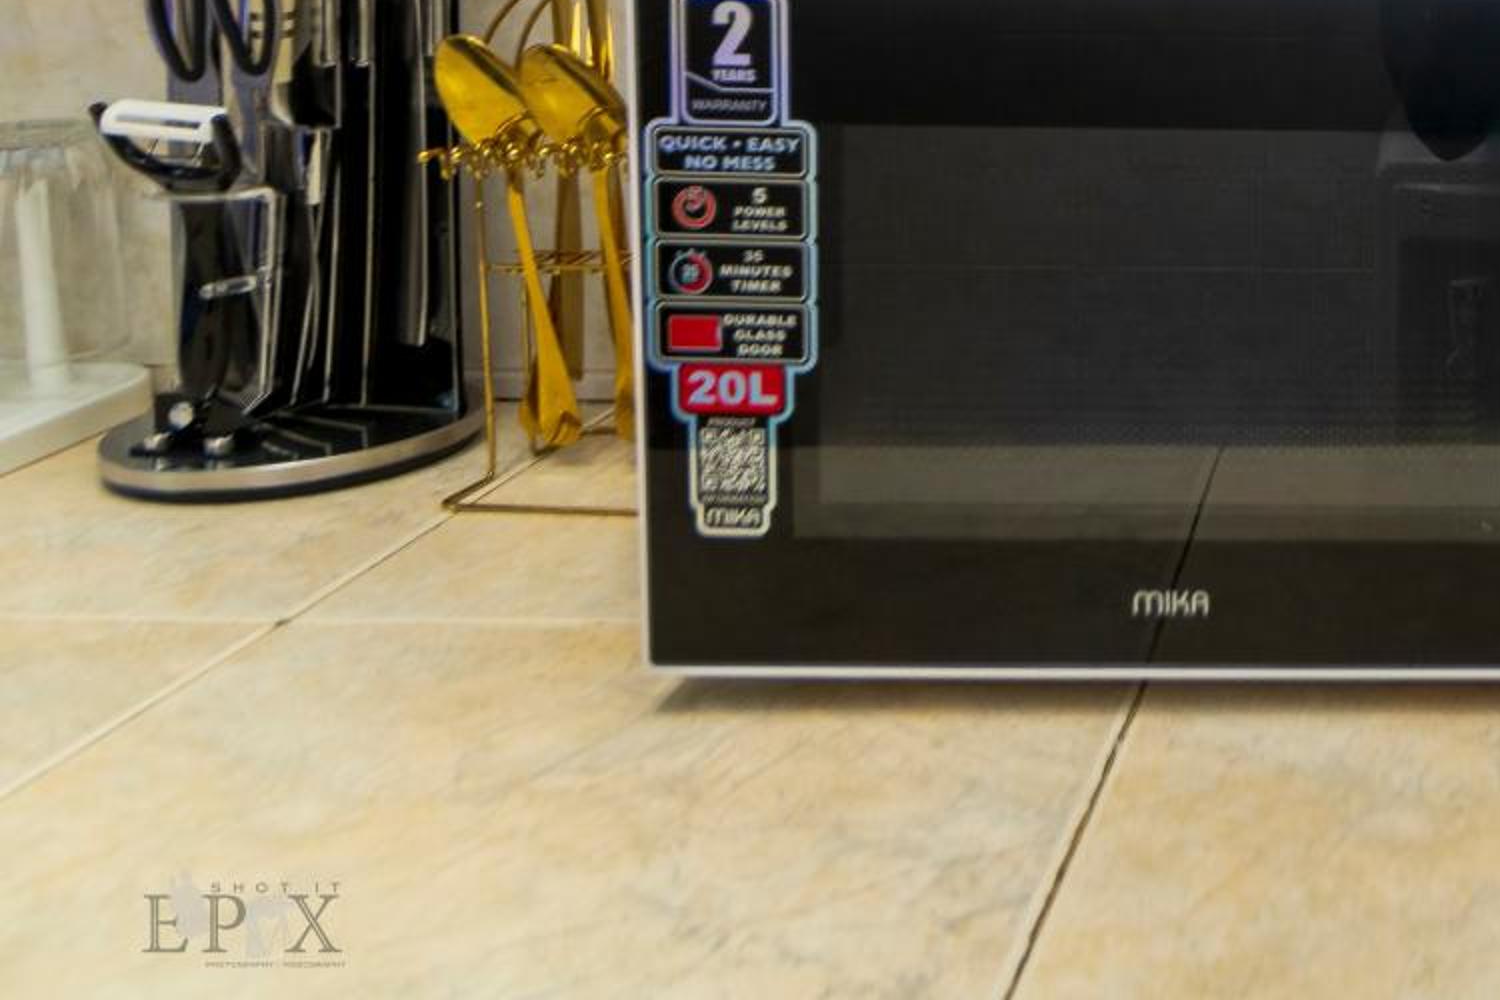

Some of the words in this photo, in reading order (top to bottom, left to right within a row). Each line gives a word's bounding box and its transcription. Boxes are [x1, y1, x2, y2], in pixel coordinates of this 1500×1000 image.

[712, 0, 753, 67] 2
[711, 68, 757, 83] YEARS
[659, 135, 728, 152] QUICK
[745, 137, 800, 153] EASY
[684, 154, 718, 170] NO
[721, 155, 776, 171] MESS
[751, 186, 768, 205] 5
[733, 205, 786, 217] POWER
[732, 219, 788, 232] LEVELS
[719, 264, 793, 279] MINUTES
[731, 279, 782, 294] TIMER
[733, 329, 787, 342] GLASS
[687, 370, 778, 406] 20L
